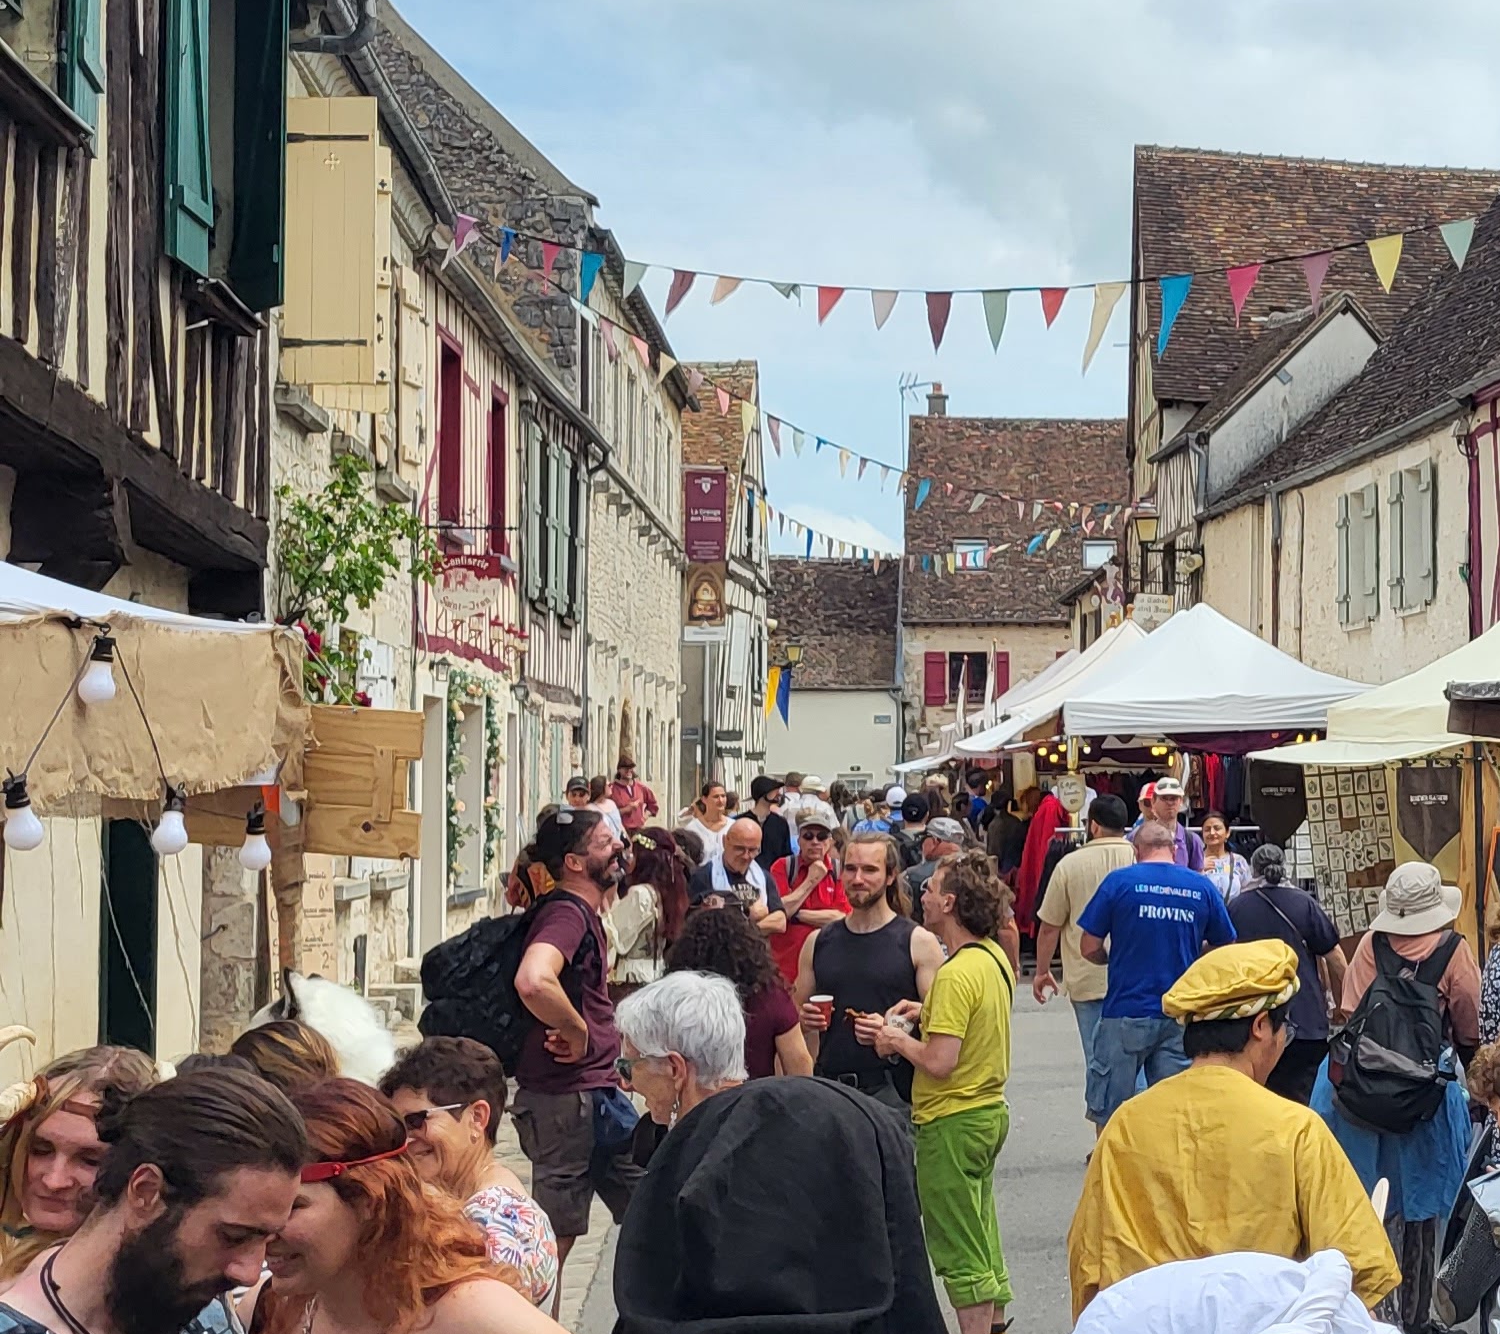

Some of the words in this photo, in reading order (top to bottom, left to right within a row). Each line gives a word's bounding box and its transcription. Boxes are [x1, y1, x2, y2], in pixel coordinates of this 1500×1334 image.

[441, 556, 489, 570] Confiserie
[1135, 884, 1148, 893] LES
[1192, 890, 1202, 900] DE
[1139, 904, 1194, 923] PROVINS
